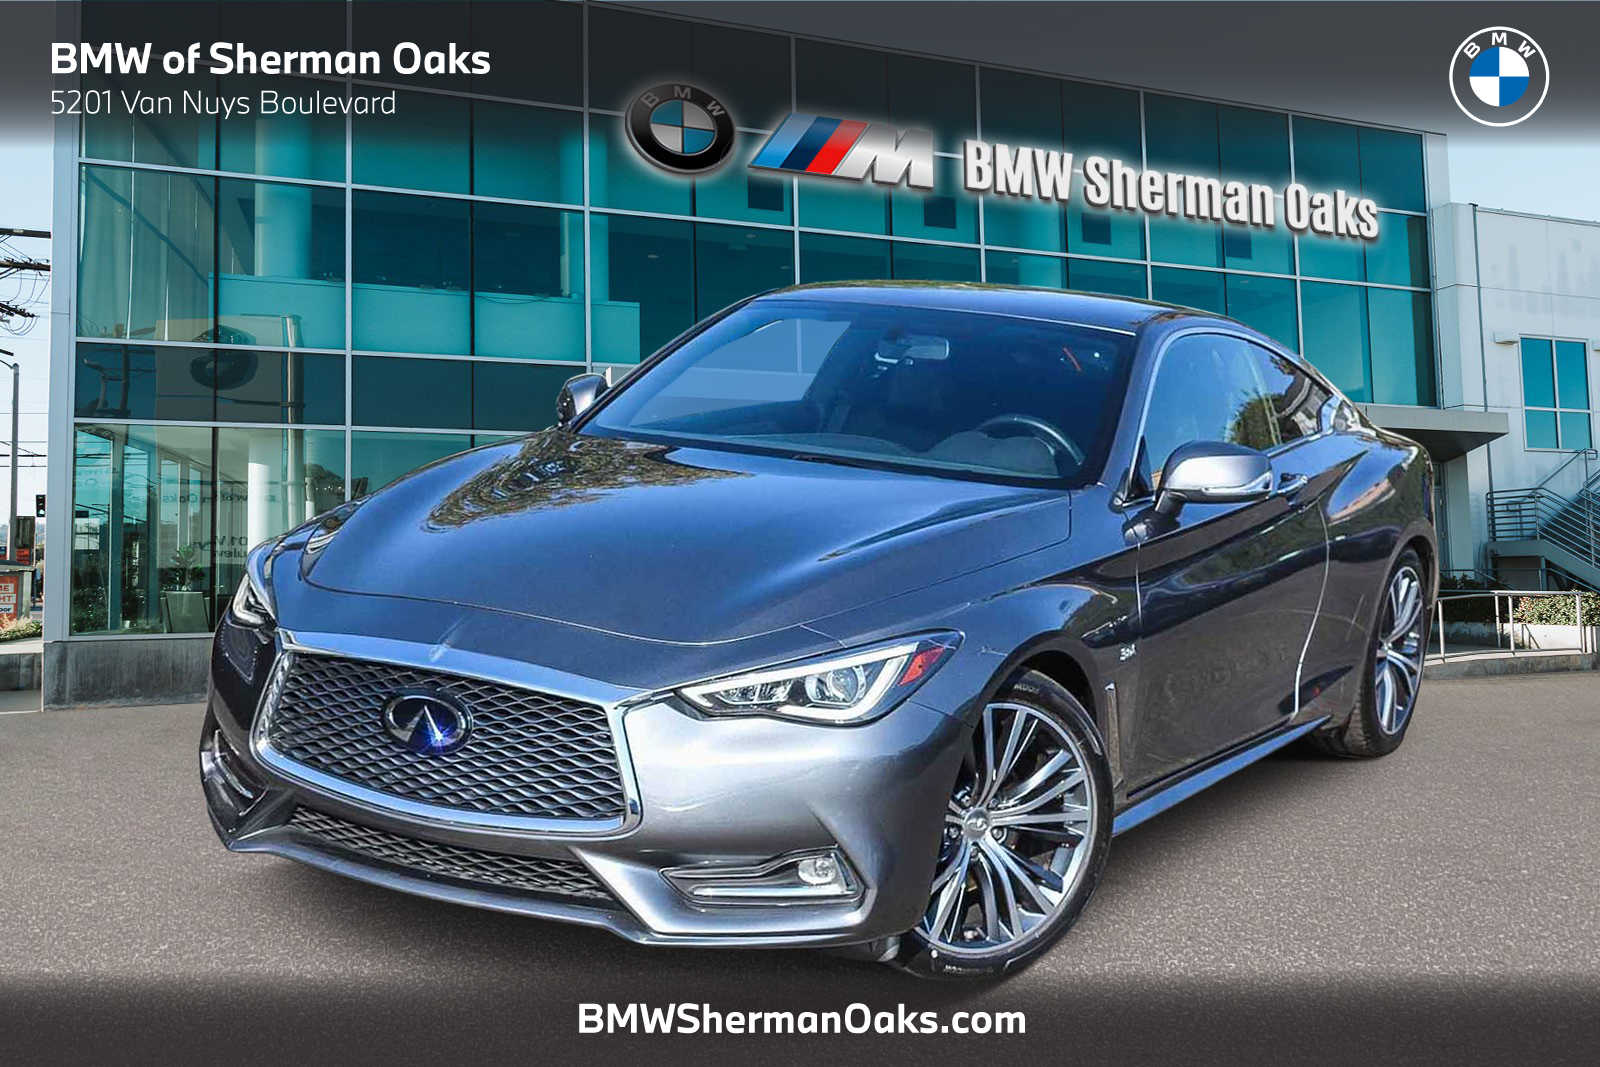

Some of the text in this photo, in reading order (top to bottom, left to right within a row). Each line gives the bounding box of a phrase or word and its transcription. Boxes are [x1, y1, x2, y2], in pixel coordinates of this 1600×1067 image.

[641, 85, 726, 117] BMW
[963, 139, 1379, 240] BMW Sherman Oaks
